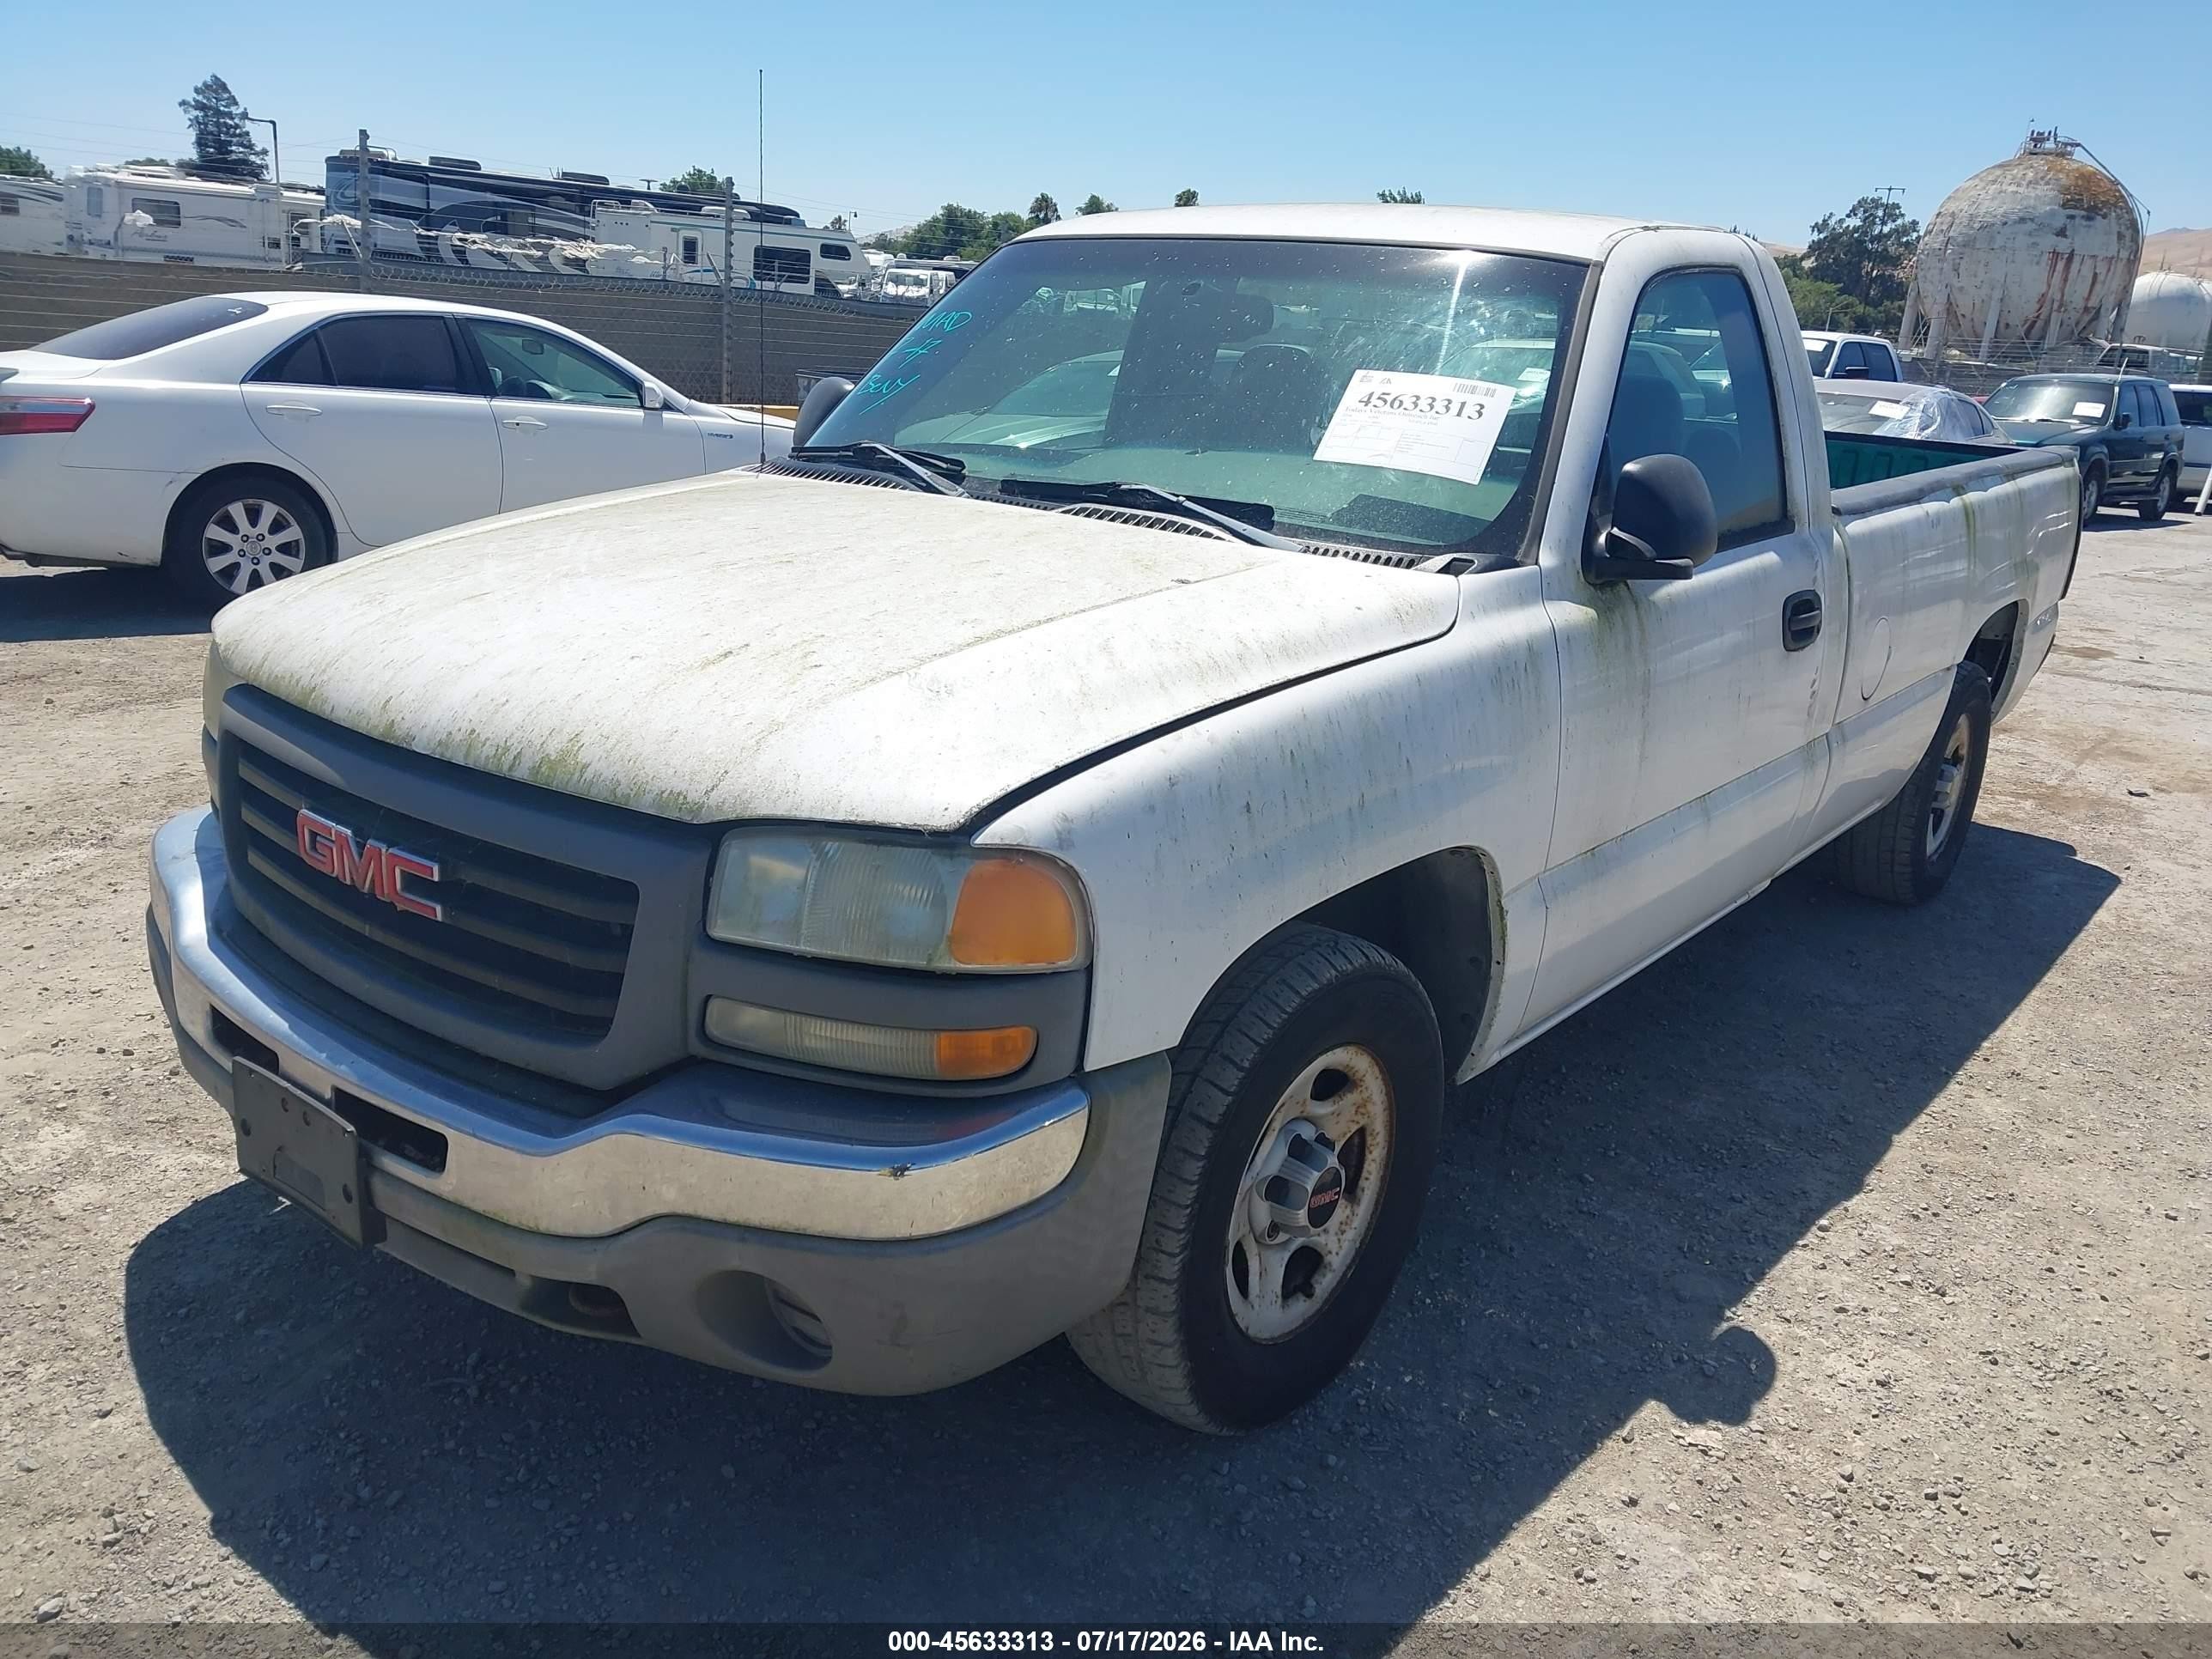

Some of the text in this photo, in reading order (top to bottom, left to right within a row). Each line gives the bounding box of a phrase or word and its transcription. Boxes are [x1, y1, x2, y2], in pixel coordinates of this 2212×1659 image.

[1358, 391, 1486, 421] 45633313
[296, 809, 442, 922] GMC
[1310, 1187, 1340, 1208] GMC
